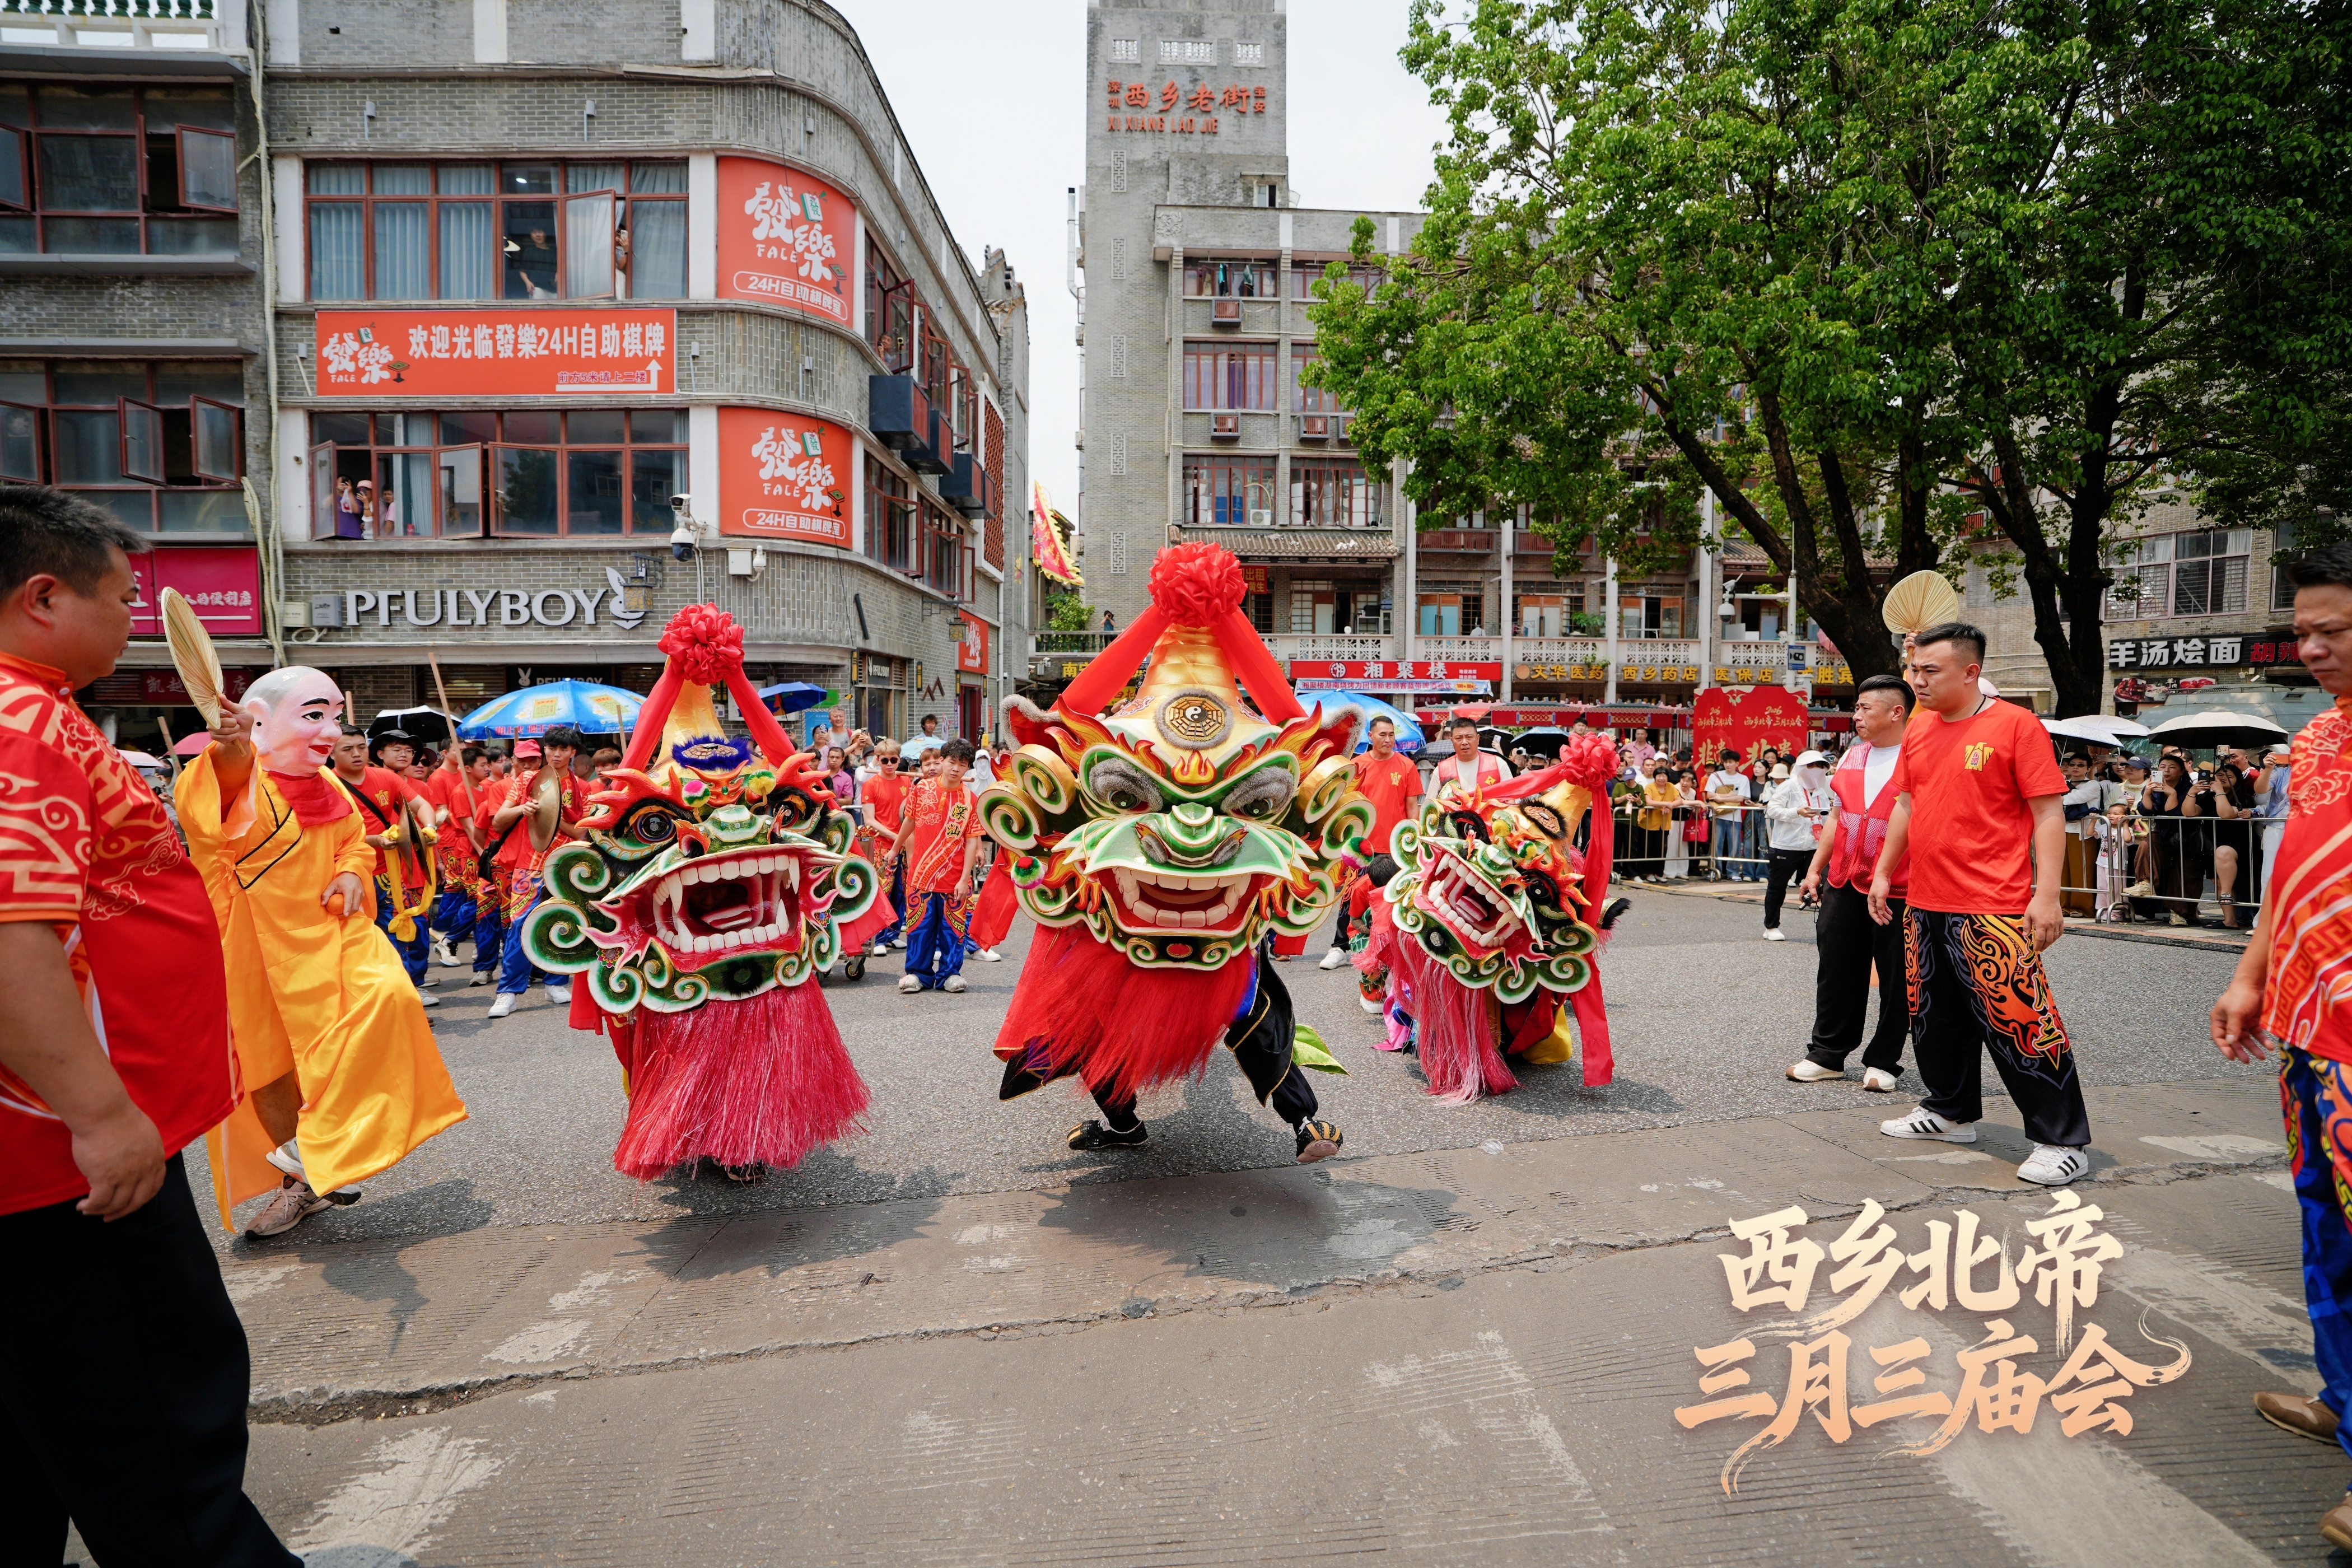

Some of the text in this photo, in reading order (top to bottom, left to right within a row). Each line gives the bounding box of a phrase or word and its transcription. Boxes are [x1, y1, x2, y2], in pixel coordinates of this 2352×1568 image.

[1108, 81, 1120, 109] 深圳
[1124, 80, 1251, 113] 西乡老街
[1253, 86, 1266, 113] 宝安
[1108, 116, 1218, 133] XI XIANG LAO JIE
[744, 181, 836, 282] 發樂
[748, 276, 841, 315] 24H自助棋牌室
[408, 322, 665, 359] 欢迎光临發樂24H自助棋牌
[321, 332, 394, 384] 發樂
[558, 371, 647, 384] 前方5米请上二楼
[752, 427, 834, 511] 發樂
[757, 512, 841, 536] 24H自助棋牌室
[157, 590, 251, 607] 人的便利店
[346, 589, 608, 627] PFULYBOY
[2109, 637, 2243, 668] 羊汤烩面
[1363, 661, 1448, 679] 湘聚楼
[1530, 664, 1604, 680] 文华医药
[1622, 666, 1698, 681] 西乡药店
[1715, 668, 1774, 682] 医保店
[1744, 715, 1804, 730] 西乡北帝 三月三庙会
[1765, 706, 1782, 715] 2026
[947, 804, 967, 837] 深汕
